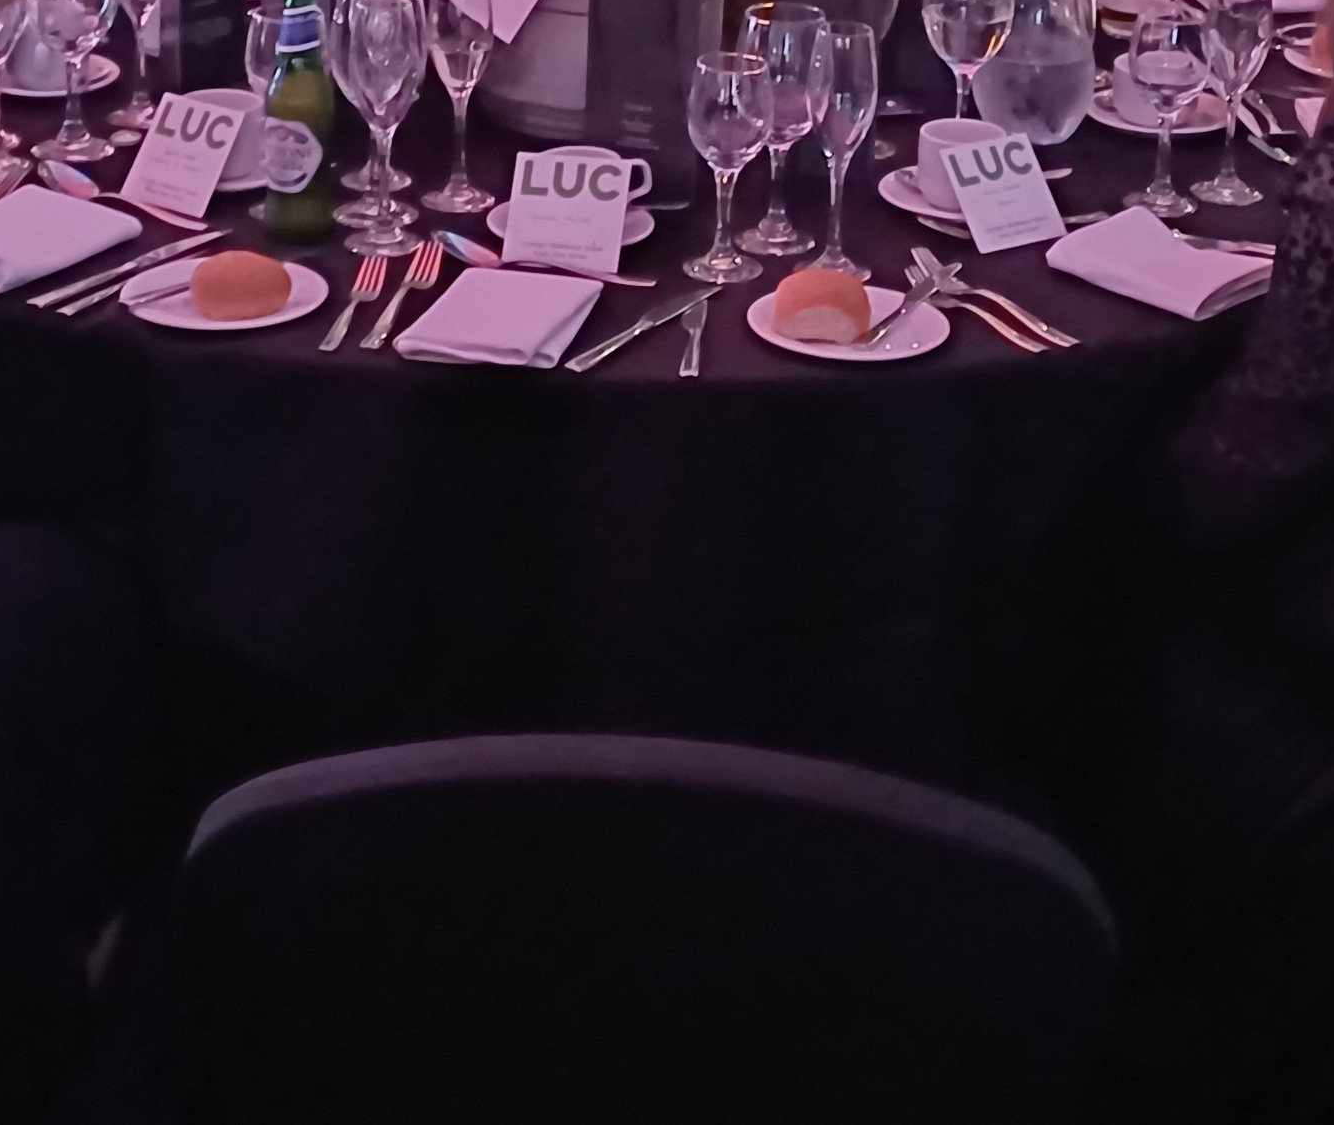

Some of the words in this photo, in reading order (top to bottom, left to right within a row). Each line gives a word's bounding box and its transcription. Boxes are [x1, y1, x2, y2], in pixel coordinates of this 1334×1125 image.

[155, 101, 234, 150] LUC
[520, 160, 622, 202] LUC
[948, 141, 1033, 187] LUC
